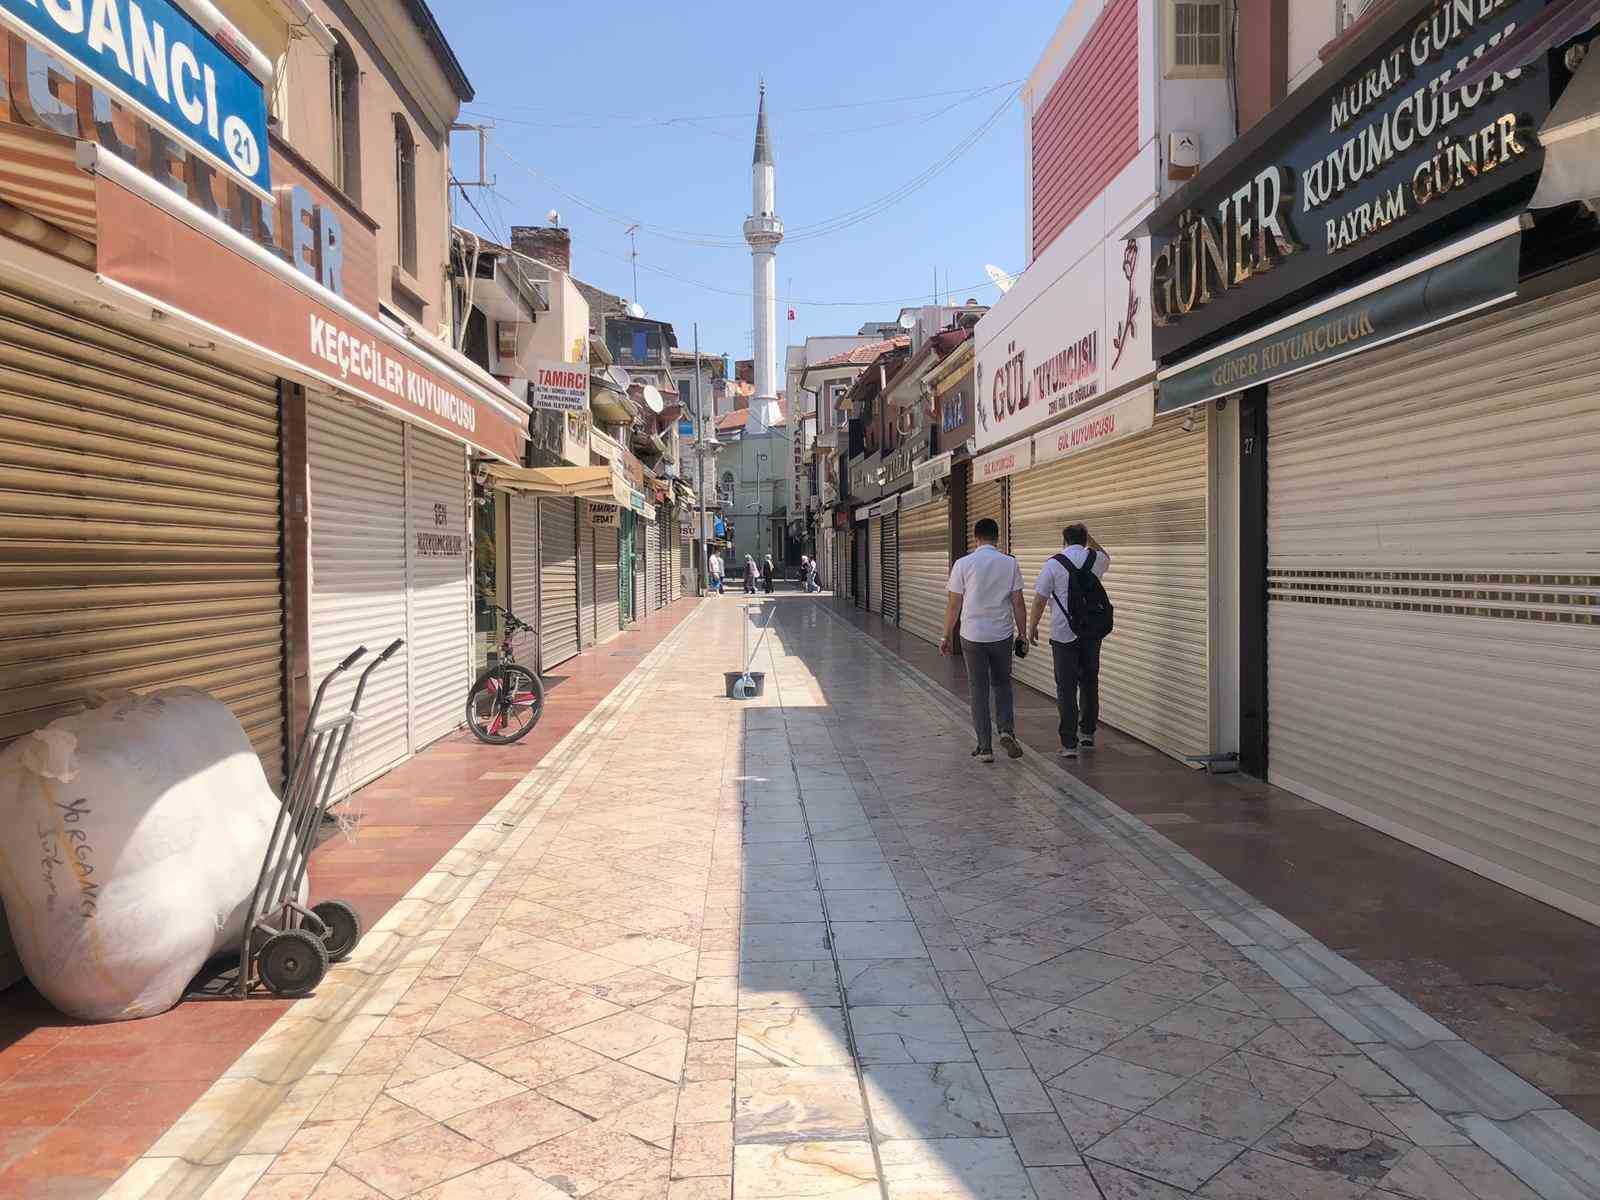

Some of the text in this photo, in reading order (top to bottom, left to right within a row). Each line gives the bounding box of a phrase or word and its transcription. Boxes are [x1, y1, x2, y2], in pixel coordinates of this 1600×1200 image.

[1329, 46, 1404, 133] MURAT
[232, 128, 251, 157] 21
[1326, 112, 1525, 254] BAYRAM GÜNER
[1151, 165, 1294, 327] GÜNER
[309, 313, 475, 433] KEÇECİLER KUYUMCUSU
[993, 340, 1031, 422] GÜL
[1212, 311, 1375, 386] GÜNER KUYUMCULUK
[1071, 415, 1115, 445] KUYUMCUSU
